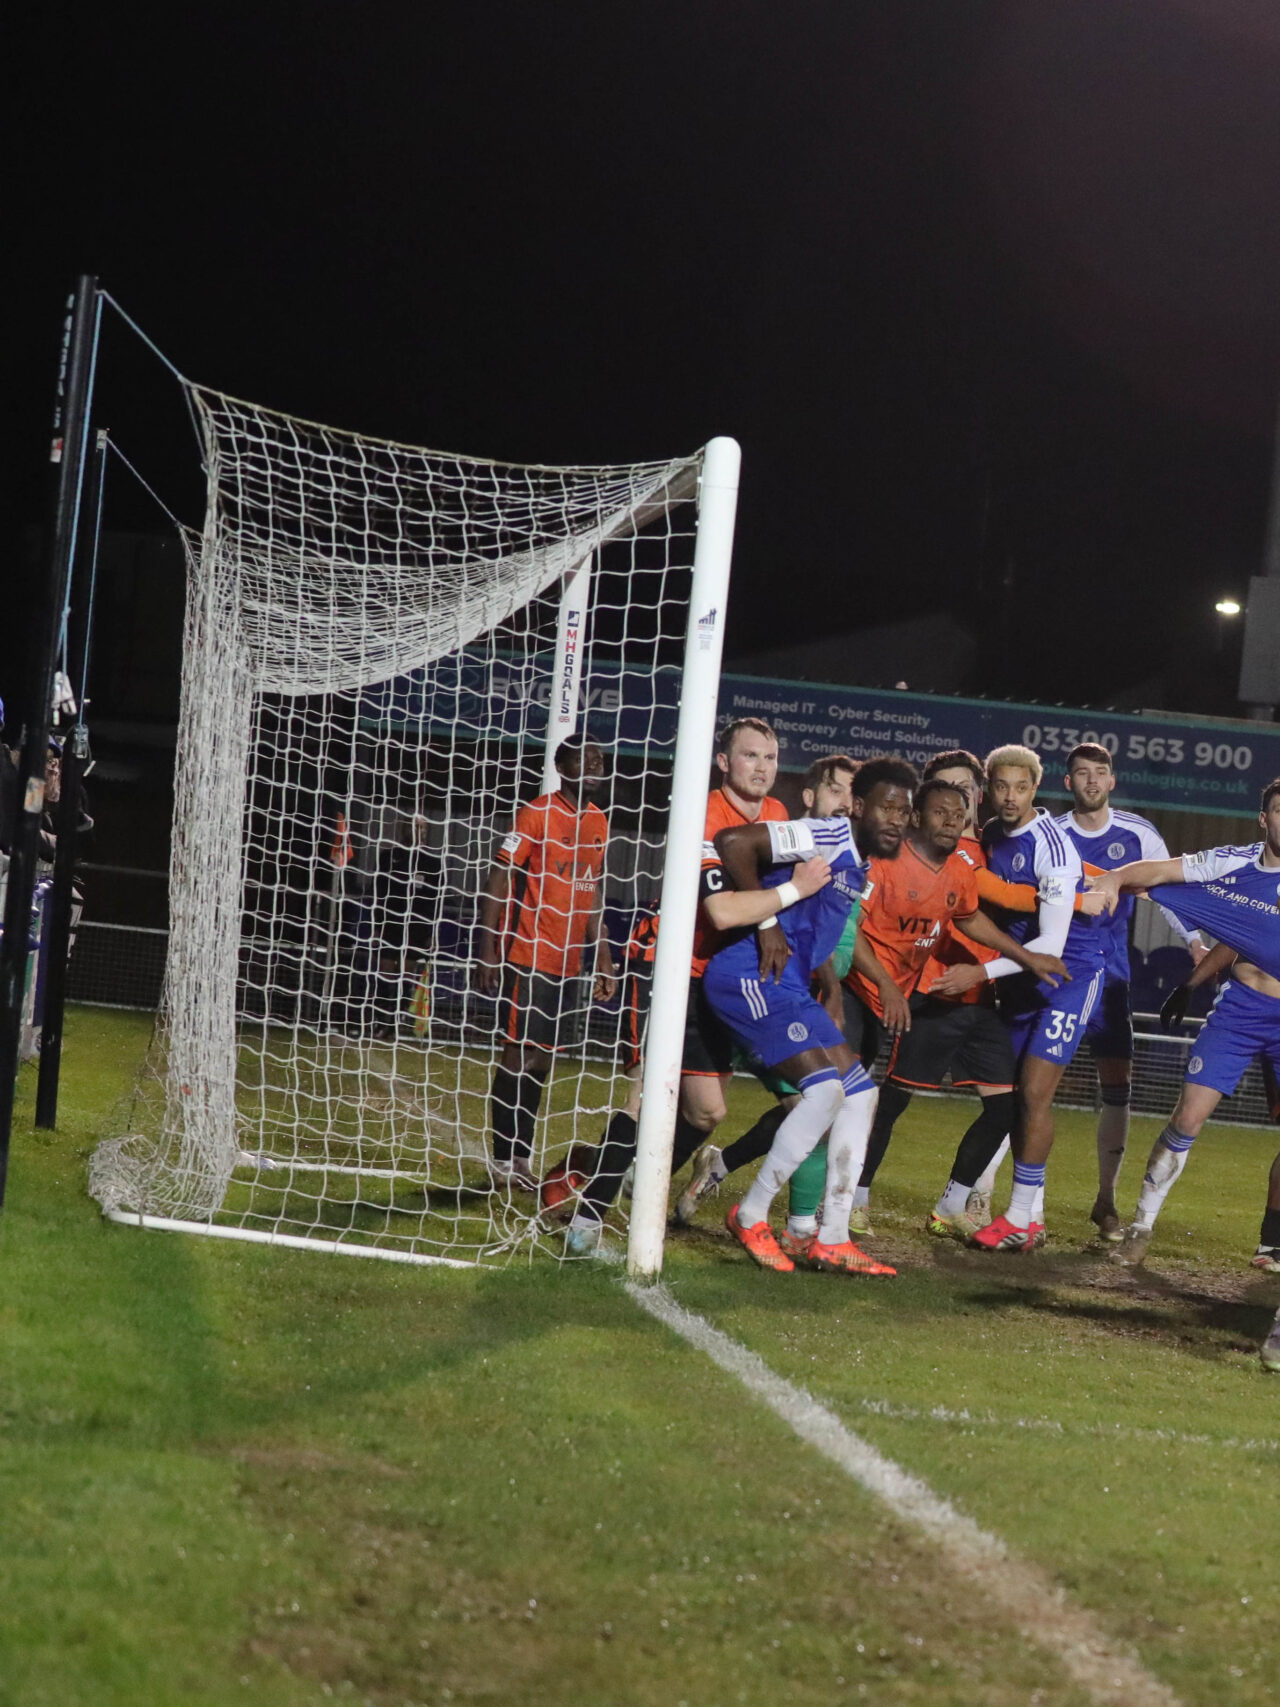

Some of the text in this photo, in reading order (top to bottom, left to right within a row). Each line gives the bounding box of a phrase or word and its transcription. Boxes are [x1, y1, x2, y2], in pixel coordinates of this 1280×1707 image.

[733, 695, 931, 728] Managed IT Cyber Security
[774, 719, 960, 749] Recovery Cloud Solutions
[1126, 735, 1185, 763] 563
[1194, 742, 1253, 770] 900
[706, 869, 723, 891] C
[1226, 892, 1249, 904] AND
[898, 915, 941, 937] VITA
[1045, 1010, 1077, 1043] 35
